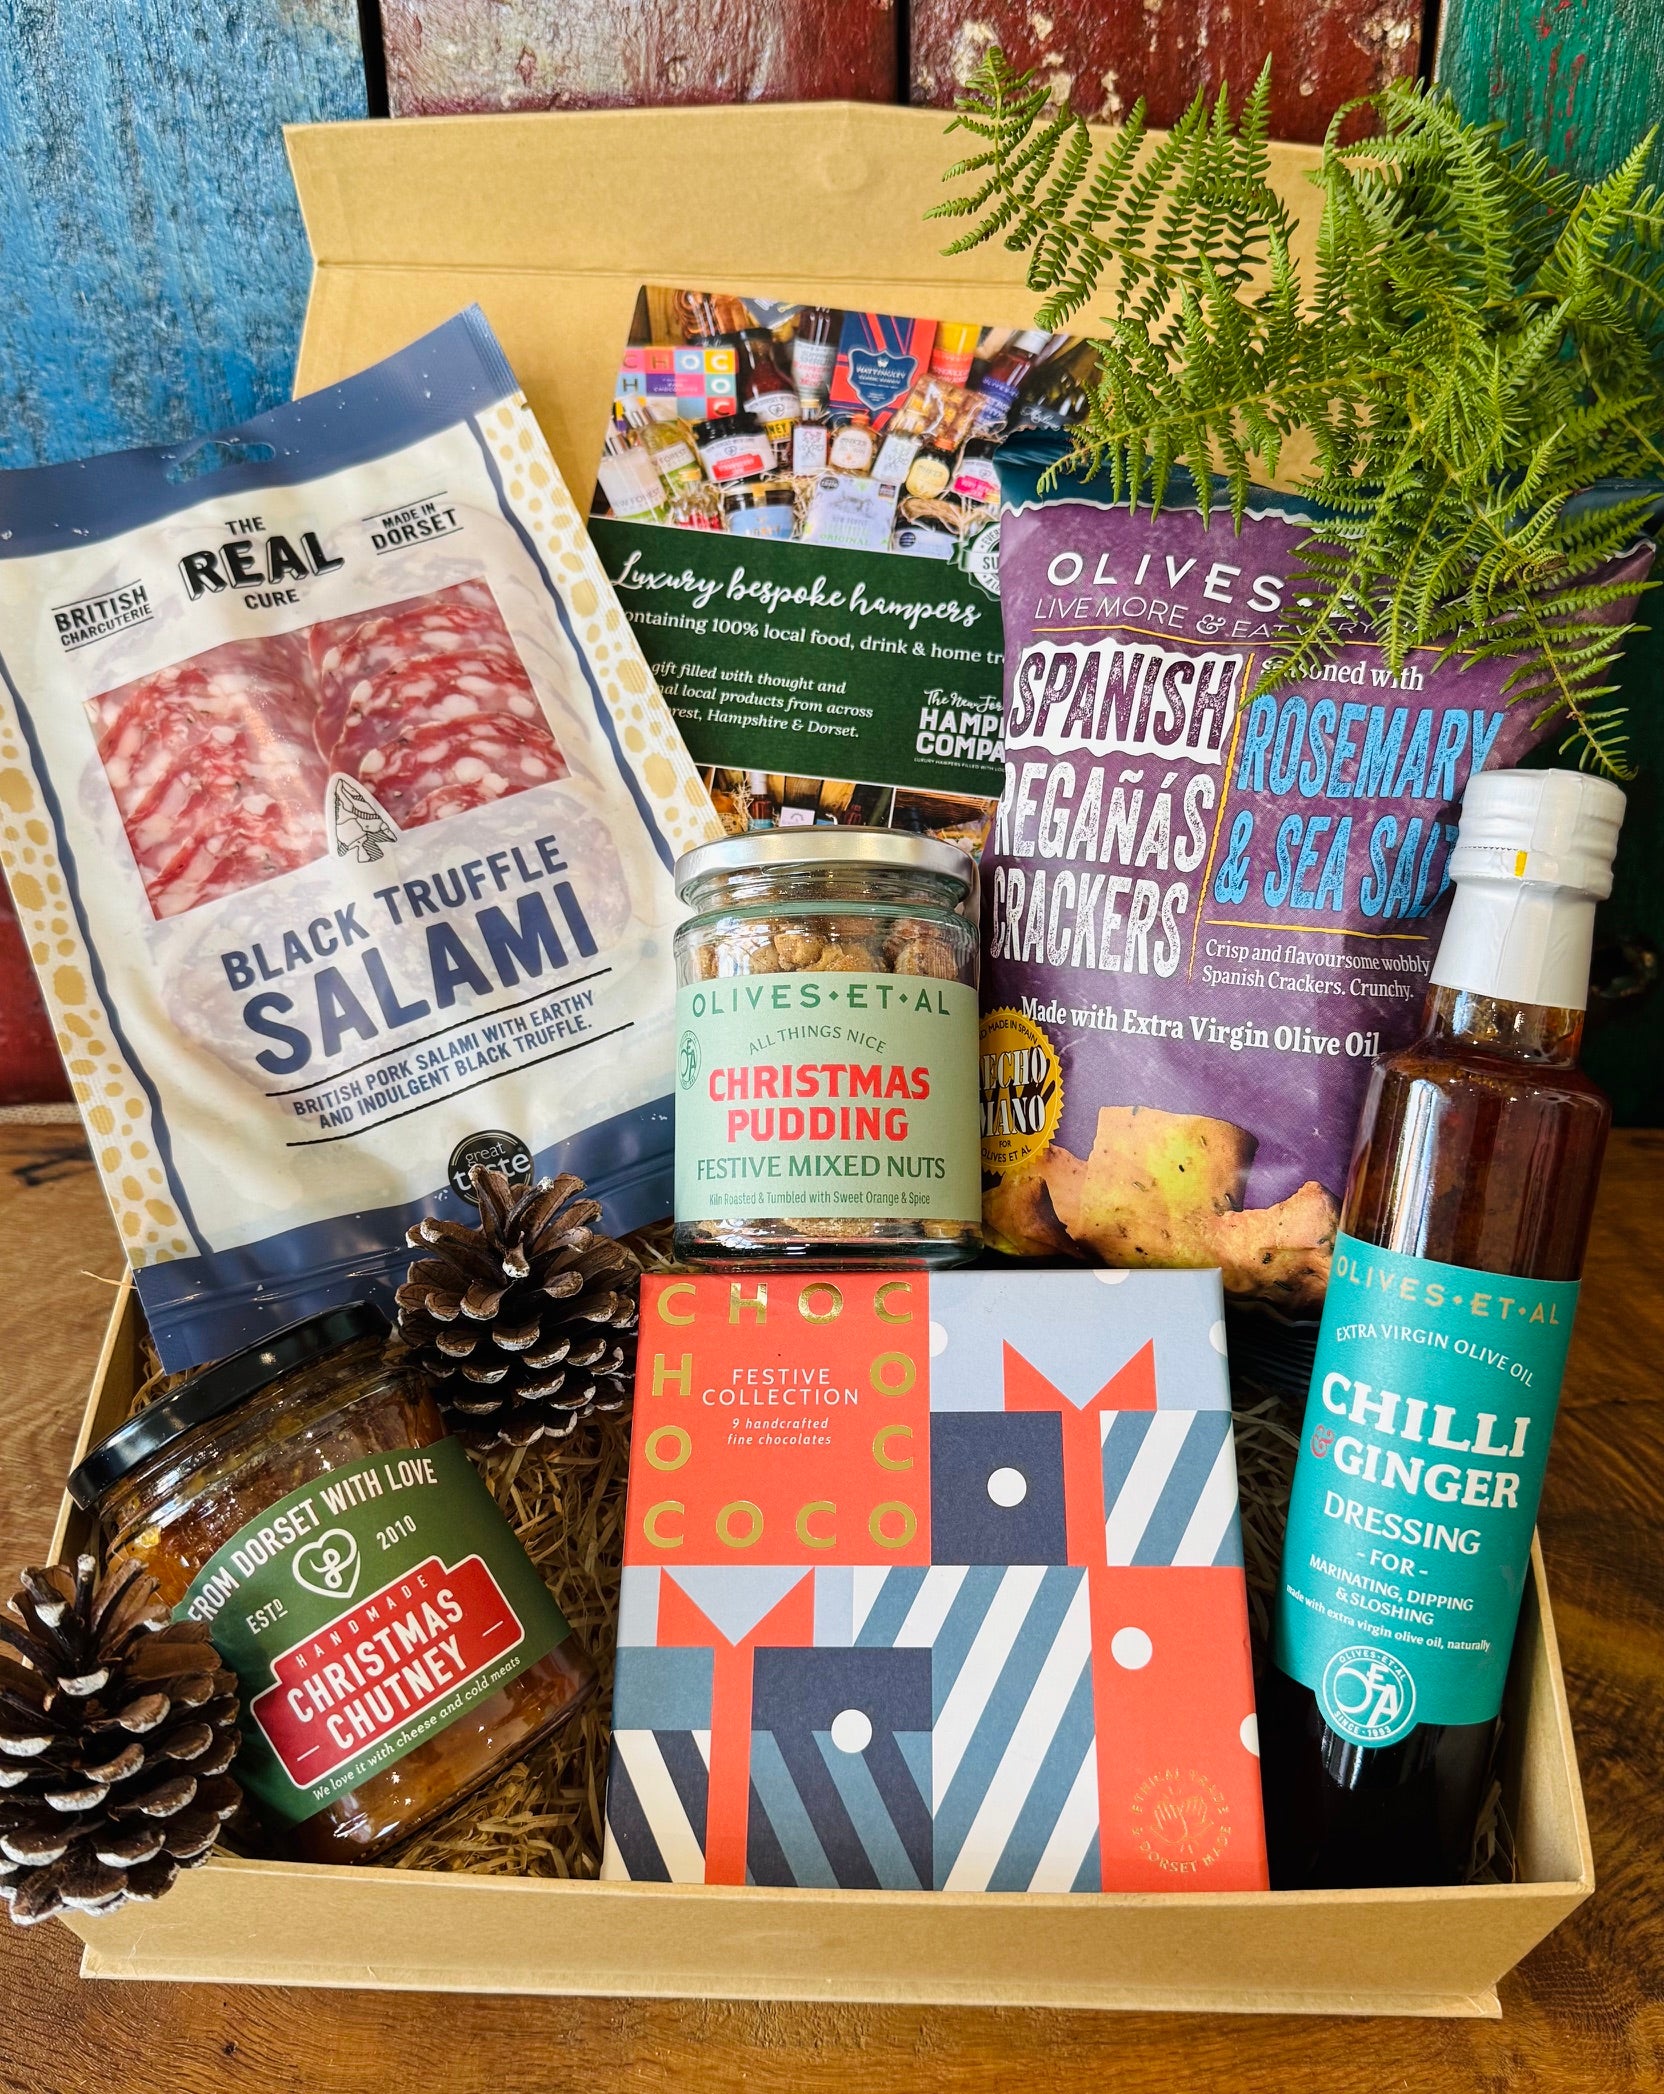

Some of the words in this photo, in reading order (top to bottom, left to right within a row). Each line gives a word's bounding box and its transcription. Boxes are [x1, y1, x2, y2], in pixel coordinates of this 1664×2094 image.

[225, 516, 266, 536] THE
[371, 508, 458, 551] DORSET
[381, 508, 420, 530] MADE
[421, 502, 436, 516] IN
[178, 531, 345, 602] REAL
[1047, 552, 1285, 613] OLIVES
[53, 585, 150, 634] BRITISH
[244, 588, 300, 611] CURE
[610, 549, 725, 610] Luxury
[726, 565, 846, 615] bespoke
[849, 581, 982, 631] hampers
[60, 602, 153, 648] CHARCUTERIE
[624, 610, 708, 636] ontaining
[712, 617, 759, 638] 100%
[763, 624, 806, 644] local
[810, 630, 855, 651] food,
[860, 635, 908, 655] drink
[911, 642, 927, 657] &
[930, 643, 982, 664] home
[1035, 597, 1092, 619] LIVE
[1096, 596, 1189, 629] MORE
[1196, 613, 1226, 635] &
[1231, 620, 1290, 639] EAT
[651, 661, 678, 677] gift
[677, 663, 717, 679] filled
[720, 670, 754, 685] with
[757, 673, 814, 692] thought
[817, 681, 847, 695] and
[924, 688, 949, 706] The
[950, 692, 977, 709] New
[1370, 665, 1425, 691] with
[681, 685, 717, 700] local
[719, 689, 784, 708] products
[785, 697, 823, 712] from
[826, 703, 874, 719] across
[1009, 651, 1237, 750] SPANISH
[707, 709, 789, 729] Hampshire
[791, 719, 804, 731] &
[807, 720, 859, 738] Dorset.
[916, 731, 1006, 764] COMPA
[1237, 693, 1505, 801] ROSEMARY
[994, 761, 1216, 873] REGAÑÁS
[1213, 810, 1255, 905] &
[1263, 814, 1353, 912] SEA
[221, 902, 370, 991] BLACK
[374, 834, 568, 925] TRUFFLE
[990, 865, 1190, 978] CRACKERS
[243, 881, 599, 1075] SALAMI
[1205, 938, 1255, 961] Crisp
[1252, 946, 1282, 963] and
[1284, 945, 1381, 971] flavoursome
[1381, 954, 1431, 976] wobbly
[1202, 965, 1264, 988] Spanish
[1268, 970, 1347, 996] Crackers.
[1349, 978, 1415, 1002] Crunchy.
[749, 1034, 776, 1055] ALL
[777, 1025, 842, 1042] THINGS
[847, 1029, 887, 1054] NICE
[988, 1019, 1009, 1034] MADE
[1010, 1019, 1017, 1030] IN
[1018, 1023, 1038, 1046] SPAIN
[1021, 995, 1067, 1025] Made
[1070, 1003, 1118, 1032] with
[1120, 1008, 1184, 1039] Extra
[1189, 1016, 1270, 1051] Virgin
[1273, 1025, 1340, 1056] Olive
[1345, 1032, 1380, 1058] Oil
[293, 1080, 363, 1117] BRITISH
[365, 1060, 411, 1096] PORK
[416, 1033, 480, 1072] SALAMI
[483, 1016, 527, 1045] WITH
[530, 990, 595, 1026] EARTHY
[319, 1104, 355, 1129] AND
[358, 1068, 451, 1115] INDULGENT
[456, 1043, 512, 1076] BLACK
[517, 1014, 593, 1053] TRUFFLE.
[708, 1063, 931, 1102] CHRISTMAS
[727, 1106, 909, 1143] PUDDING
[999, 1140, 1012, 1148] FOR
[465, 1142, 506, 1168] great
[697, 1155, 781, 1181] FESTIVE
[788, 1155, 880, 1177] MIXED
[887, 1156, 946, 1180] NUTS
[982, 1147, 1007, 1163] OLIVES
[1009, 1152, 1018, 1162] ET
[1021, 1145, 1032, 1157] AL
[709, 1193, 723, 1206] Kiln
[725, 1193, 756, 1206] Roasted
[758, 1192, 765, 1205] &
[767, 1191, 807, 1205] Tumbled
[809, 1191, 831, 1204] with
[833, 1191, 863, 1204] Sweet
[866, 1192, 899, 1207] Orange
[901, 1192, 907, 1204] &
[909, 1193, 931, 1208] Spice
[732, 1368, 831, 1386] FESTIVE
[1336, 1323, 1377, 1342] EXTRA
[1382, 1324, 1449, 1350] VIRGIN
[1453, 1339, 1510, 1371] OLIVE
[1509, 1362, 1534, 1388] OIL
[702, 1388, 859, 1406] COLLECTION
[1322, 1371, 1531, 1458] CHILLI
[727, 1433, 754, 1446] fine
[758, 1433, 832, 1446] chocolates
[732, 1417, 741, 1430] 9
[745, 1417, 830, 1430] handcrafted
[1310, 1424, 1334, 1459] &
[1333, 1435, 1520, 1509] GINGER
[188, 1567, 240, 1623] FROM
[230, 1498, 321, 1578] DORSET
[320, 1468, 384, 1516] WITH
[384, 1458, 438, 1491] LOVE
[376, 1514, 417, 1551] 2010
[1323, 1490, 1482, 1555] DRESSING
[1309, 1554, 1403, 1603] MARINATING,
[1407, 1589, 1475, 1612] DIPPING
[295, 1574, 429, 1669] HANDMADE
[1286, 1584, 1304, 1604] made
[1304, 1593, 1325, 1614] with
[1326, 1607, 1355, 1627] extra
[1357, 1619, 1392, 1639] virgin
[1394, 1630, 1425, 1645] olive
[1426, 1637, 1444, 1650] oil,
[1447, 1639, 1491, 1652] naturally
[1335, 1586, 1348, 1602] &
[1345, 1591, 1435, 1626] SLOSHING
[287, 1588, 464, 1724] CHRISTMAS
[326, 1634, 467, 1750] CHUTNEY
[312, 1785, 331, 1801] We
[331, 1772, 355, 1790] love
[355, 1761, 367, 1774] it
[368, 1743, 396, 1767] with
[396, 1714, 439, 1749] cheese
[439, 1695, 465, 1719] and
[464, 1676, 490, 1701] cold
[490, 1655, 522, 1683] meats
[1333, 1710, 1359, 1735] SINCE
[1139, 1840, 1198, 1873] DORSET
